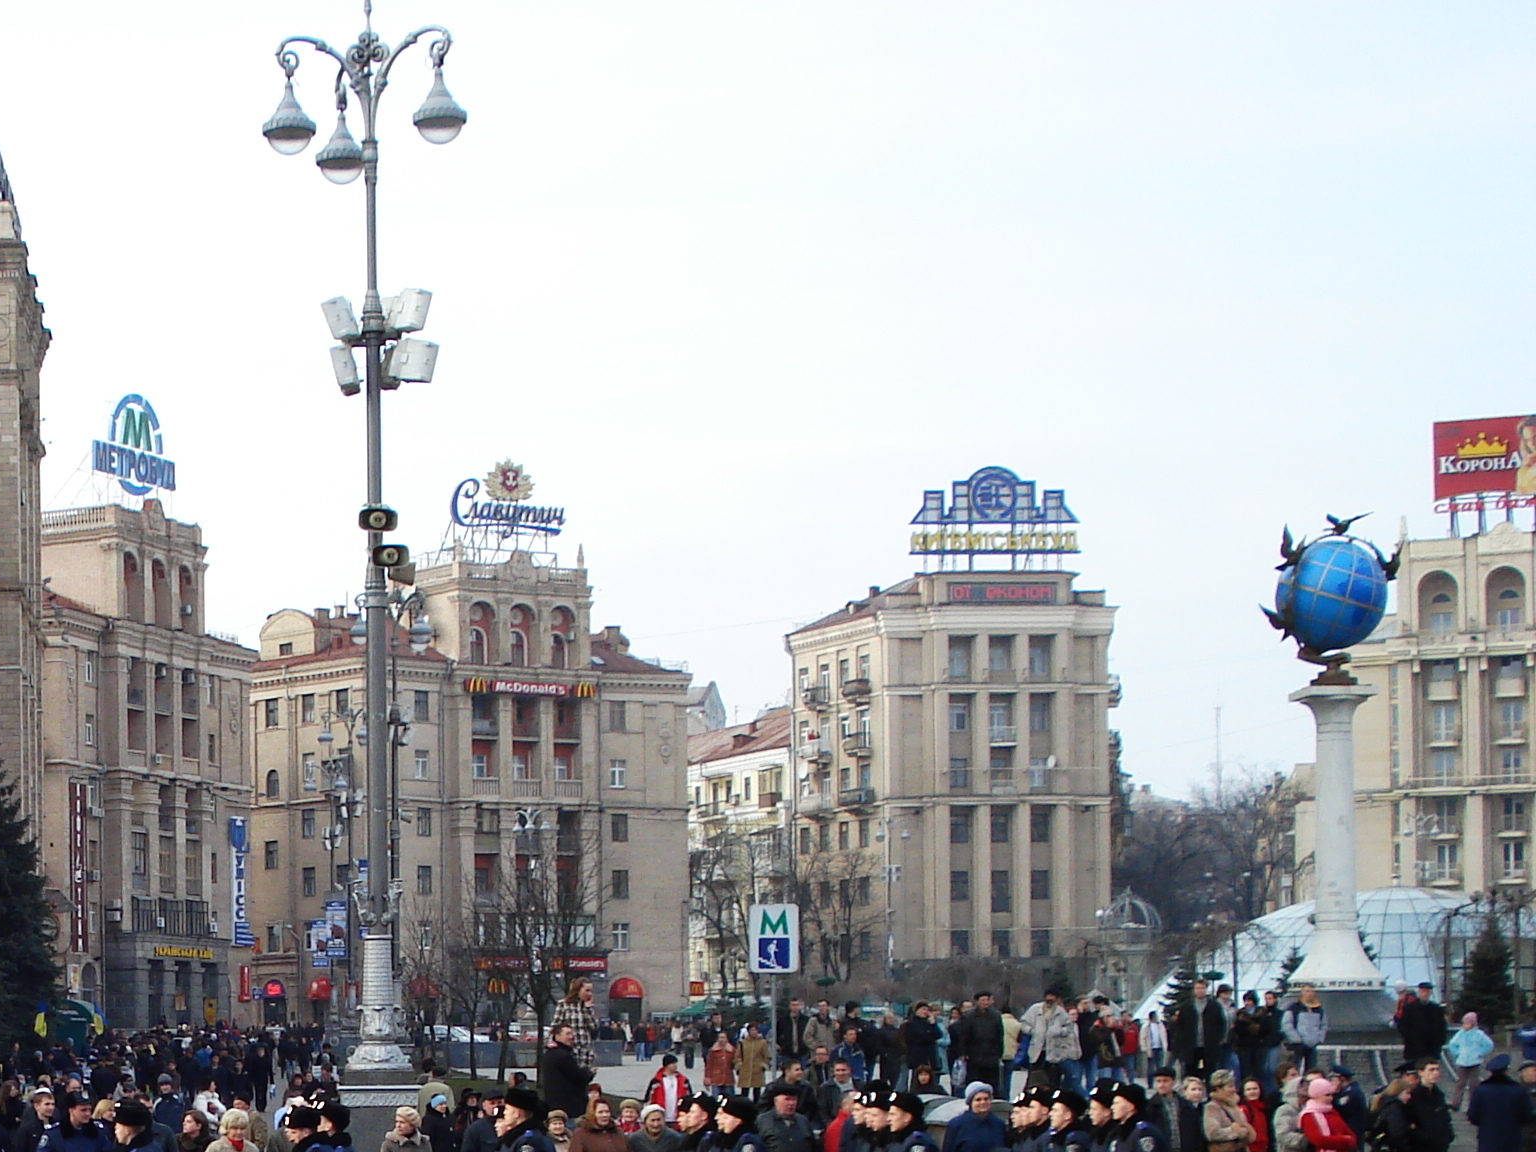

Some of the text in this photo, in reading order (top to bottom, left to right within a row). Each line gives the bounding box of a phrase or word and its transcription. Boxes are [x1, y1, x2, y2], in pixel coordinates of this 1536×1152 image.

[92, 439, 176, 491] МЕТРОБУД
[450, 478, 566, 538] Славутич
[495, 681, 565, 695] McDonald's
[760, 908, 789, 935] М
